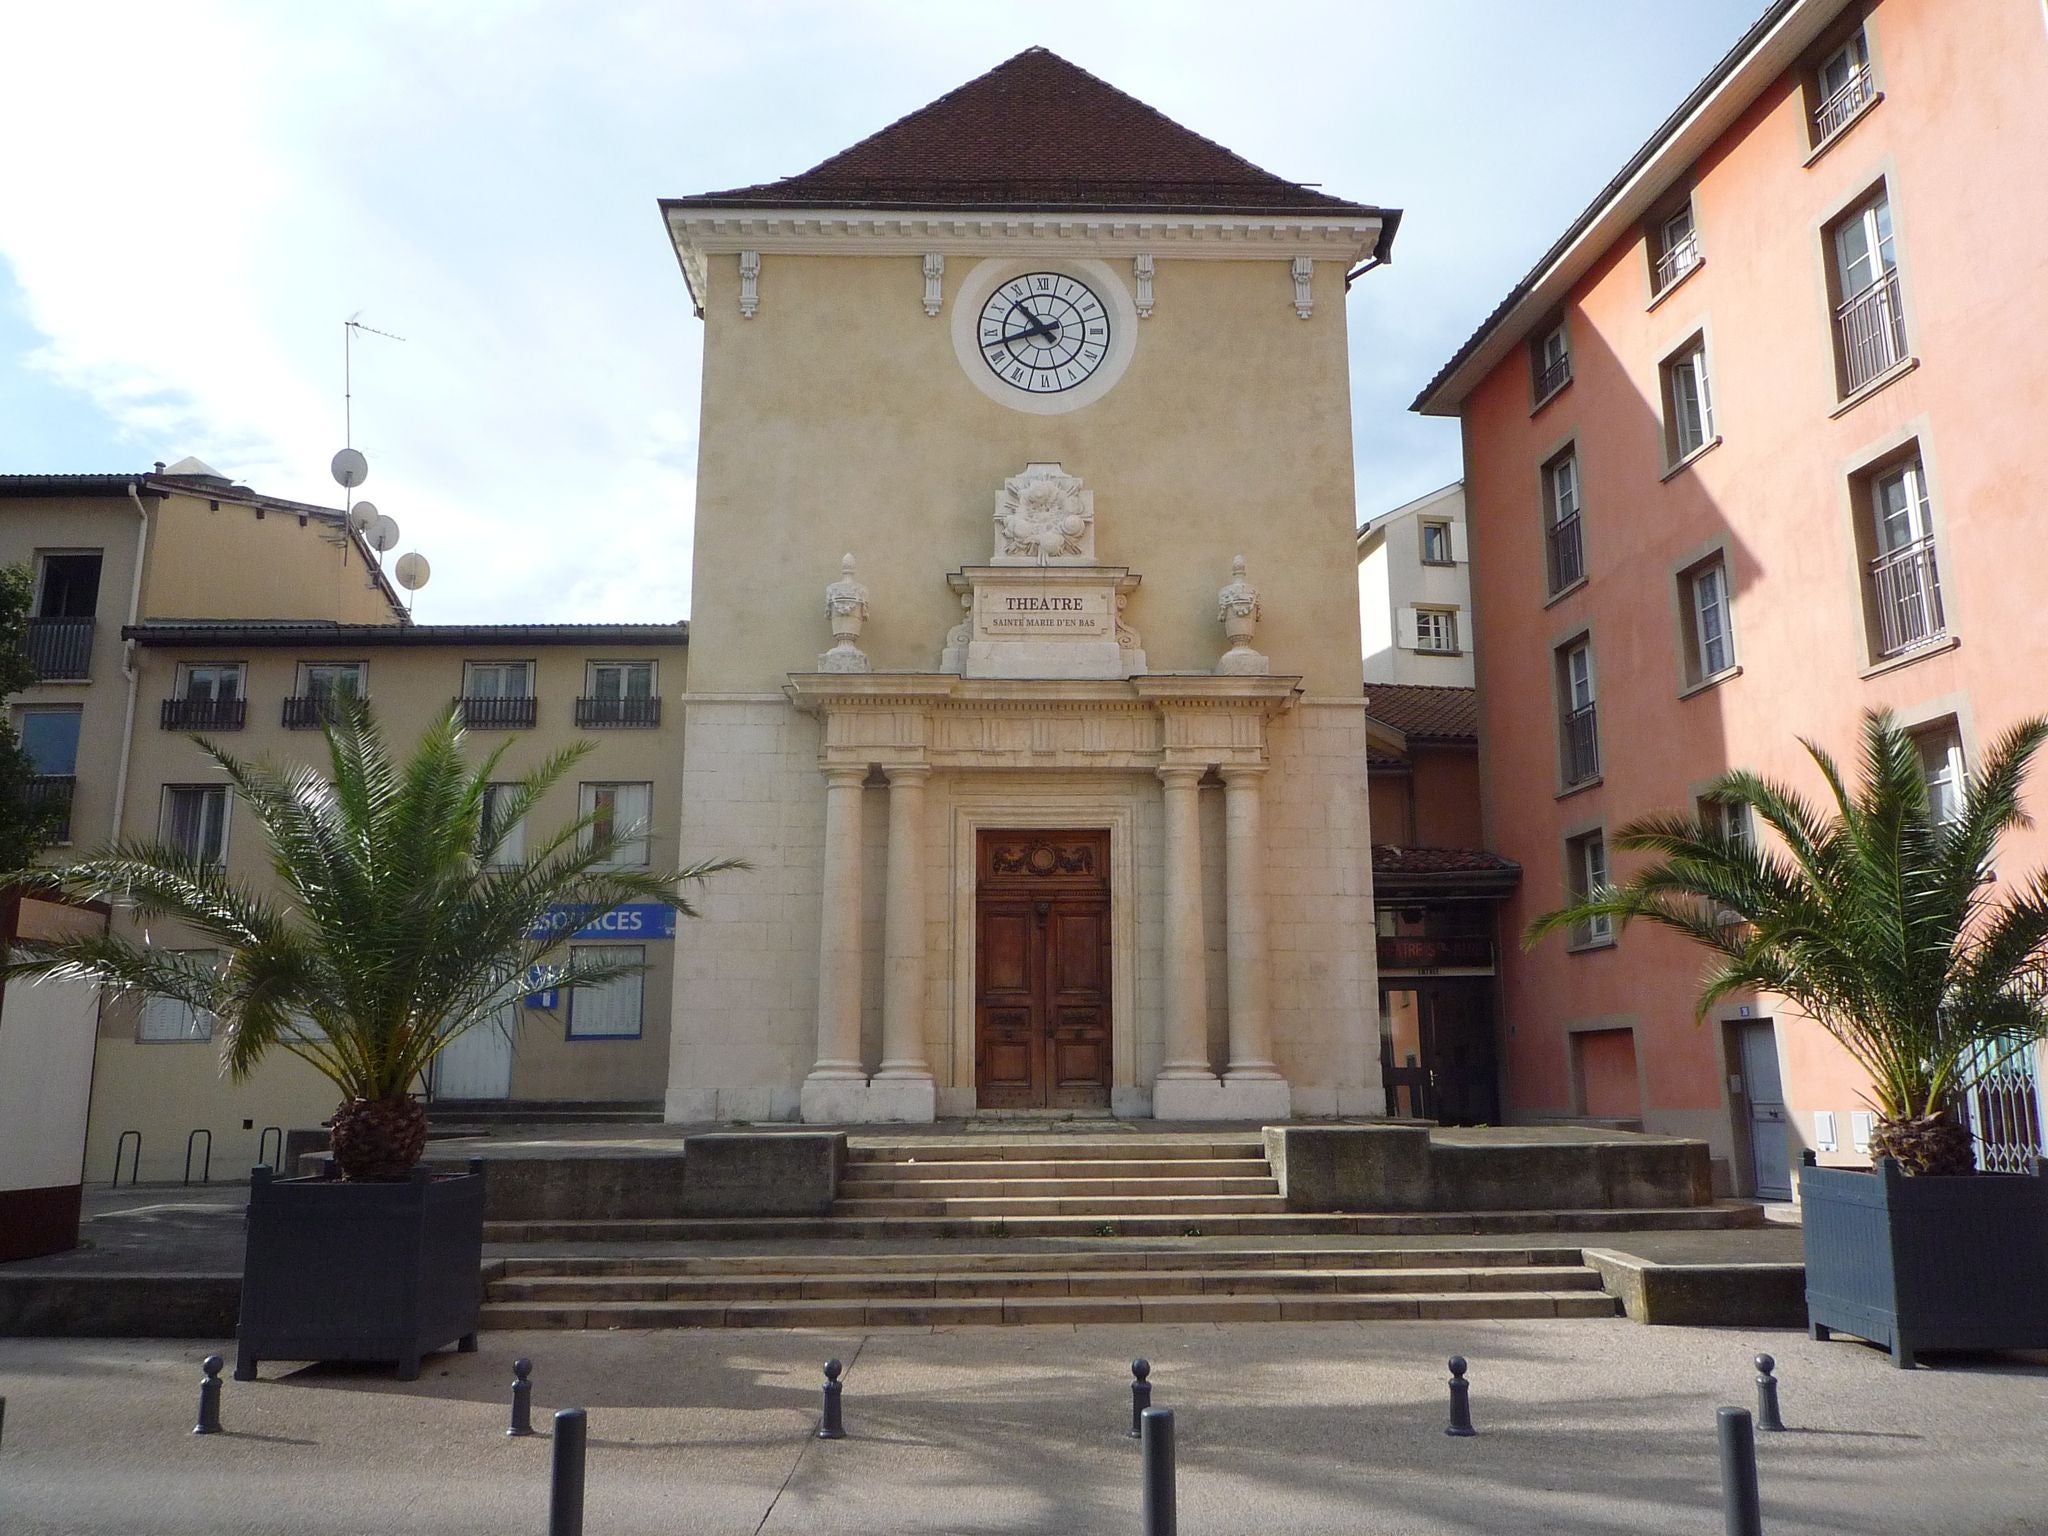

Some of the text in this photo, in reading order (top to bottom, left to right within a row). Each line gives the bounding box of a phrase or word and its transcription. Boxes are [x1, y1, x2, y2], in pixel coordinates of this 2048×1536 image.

[1037, 278, 1049, 291] XII
[1010, 284, 1023, 298] XI
[991, 303, 1005, 314] X
[1082, 303, 1096, 313] II
[1040, 374, 1051, 388] VI
[1067, 369, 1077, 381] V
[1005, 597, 1083, 610] THEATRE
[993, 619, 1095, 627] SAINTE MARIE D'EN BAS
